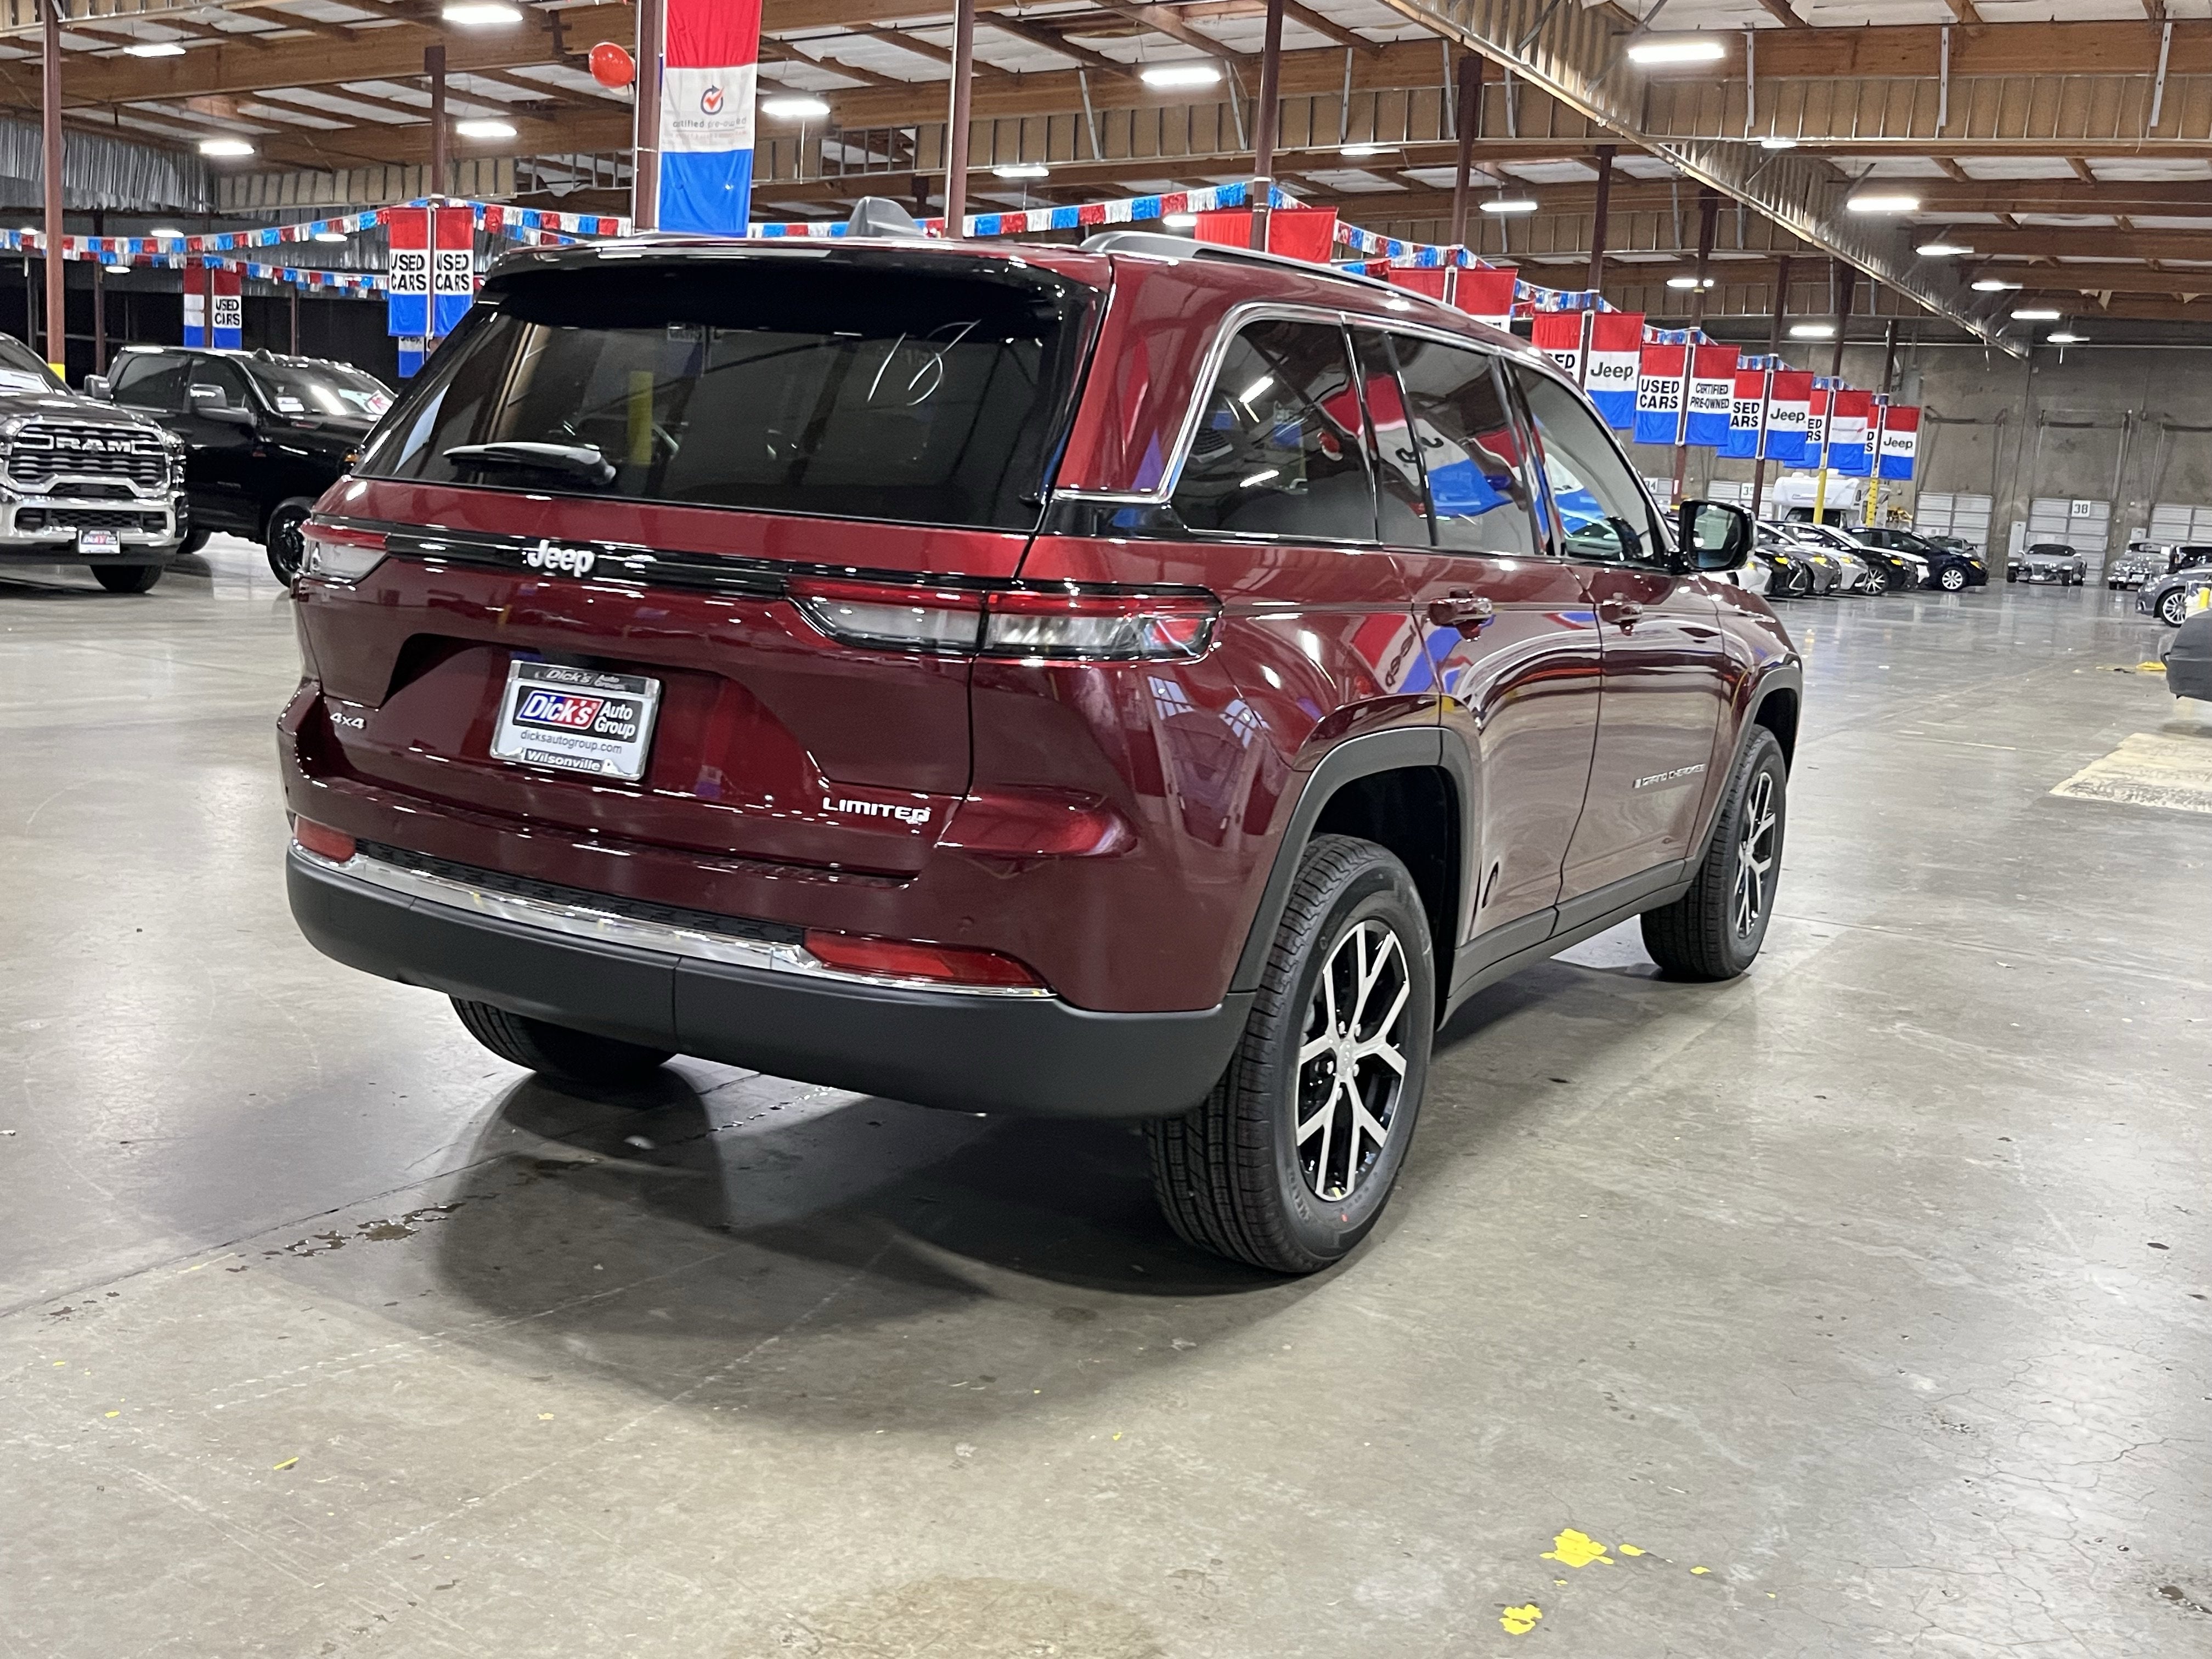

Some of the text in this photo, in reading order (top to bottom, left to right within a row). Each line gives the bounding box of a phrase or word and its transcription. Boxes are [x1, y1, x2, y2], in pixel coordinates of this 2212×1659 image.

[391, 253, 425, 271] USED
[437, 254, 469, 271] USED
[391, 273, 426, 291] CARS
[436, 273, 470, 291] CARS
[216, 299, 239, 311] USED
[1591, 362, 1633, 381] Jeep
[1641, 379, 1679, 394] USED
[1696, 383, 1728, 395] CERTIFIED
[1640, 394, 1678, 409] CARS
[1690, 396, 1730, 409] PRE-OWNED
[1770, 408, 1805, 424] Jeep
[57, 437, 130, 452] RAM
[1883, 437, 1913, 450] Jeep
[2074, 504, 2089, 514] 38
[527, 539, 595, 577] Jeep
[547, 669, 592, 684] Dick's
[523, 694, 633, 725] Dick's Auto
[330, 712, 365, 729] 4x4
[594, 715, 636, 739] Group
[521, 730, 622, 754] dicksautogroup.com
[527, 749, 601, 771] Wilsonville
[823, 797, 931, 822] LIMITED
